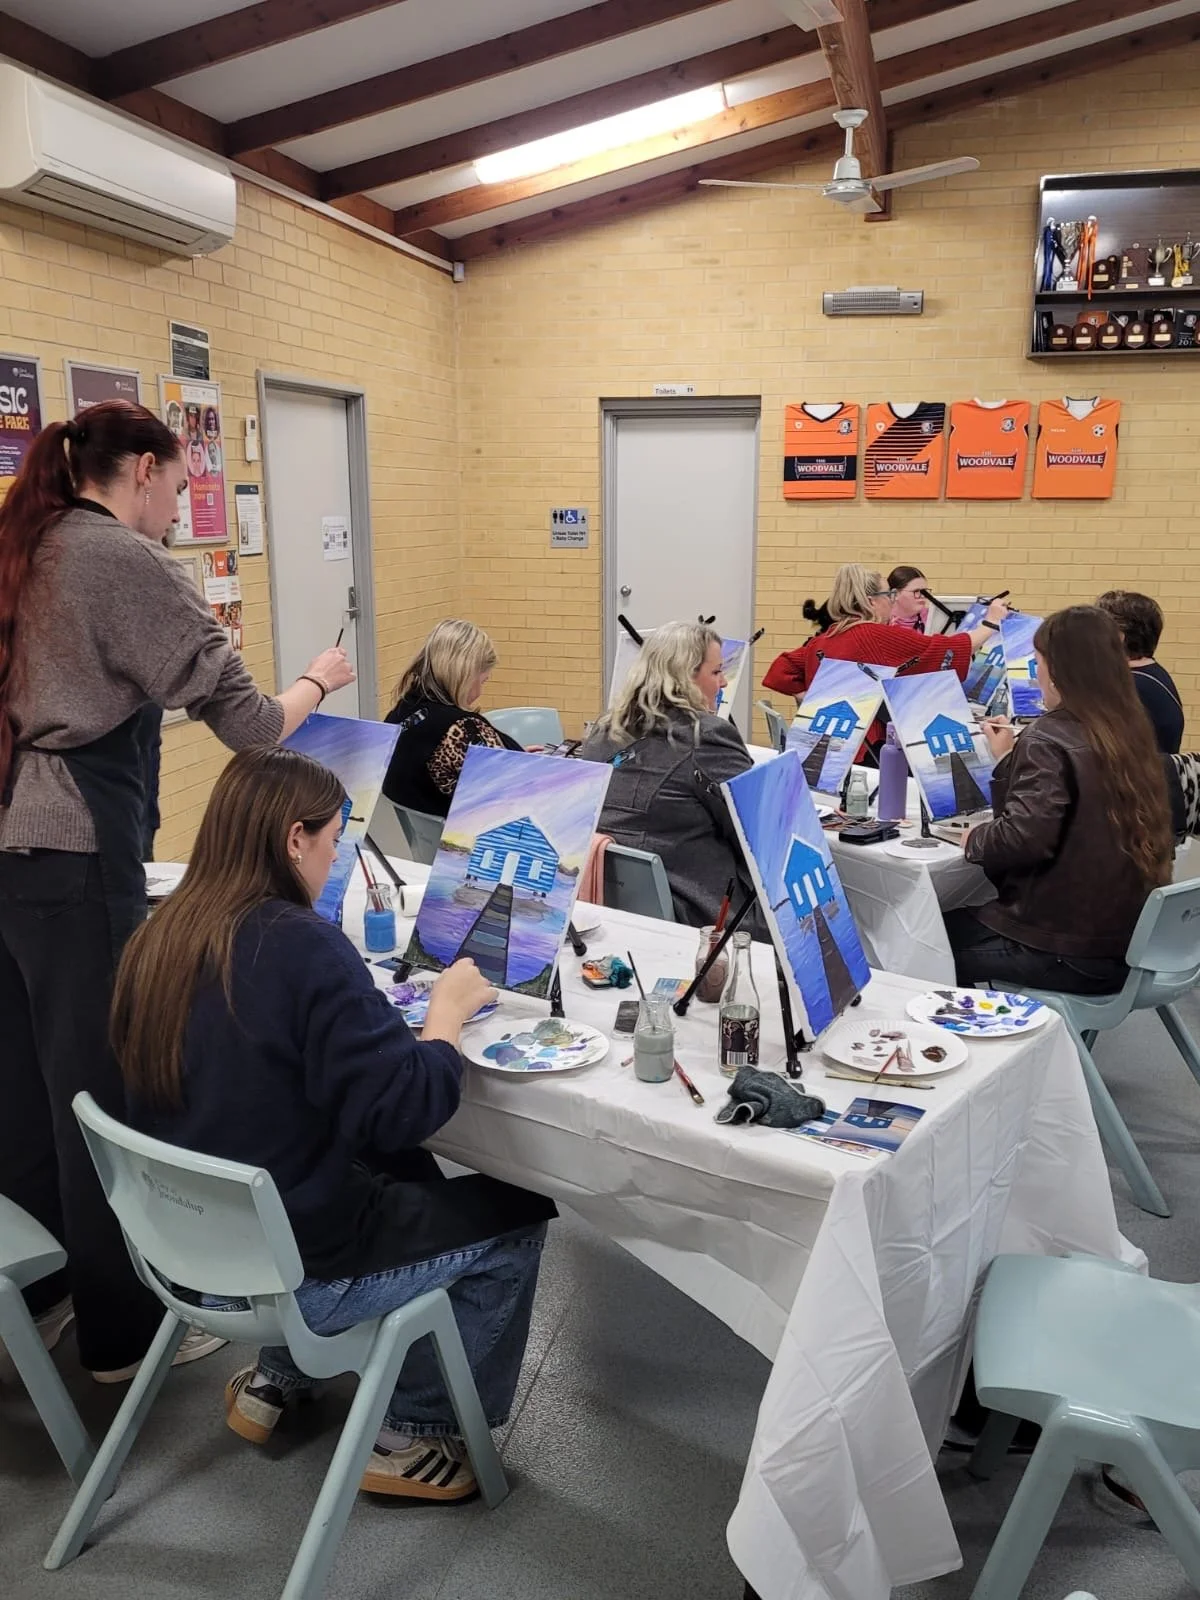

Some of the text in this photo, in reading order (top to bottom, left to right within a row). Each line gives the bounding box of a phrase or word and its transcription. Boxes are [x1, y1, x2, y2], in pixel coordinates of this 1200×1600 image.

[0, 385, 29, 415] SIC
[5, 415, 30, 430] PARK
[959, 458, 1014, 466] WOODVALE
[1048, 455, 1104, 464] WOODVALE
[797, 464, 844, 473] WOODVALE
[876, 463, 928, 472] WOODVALE
